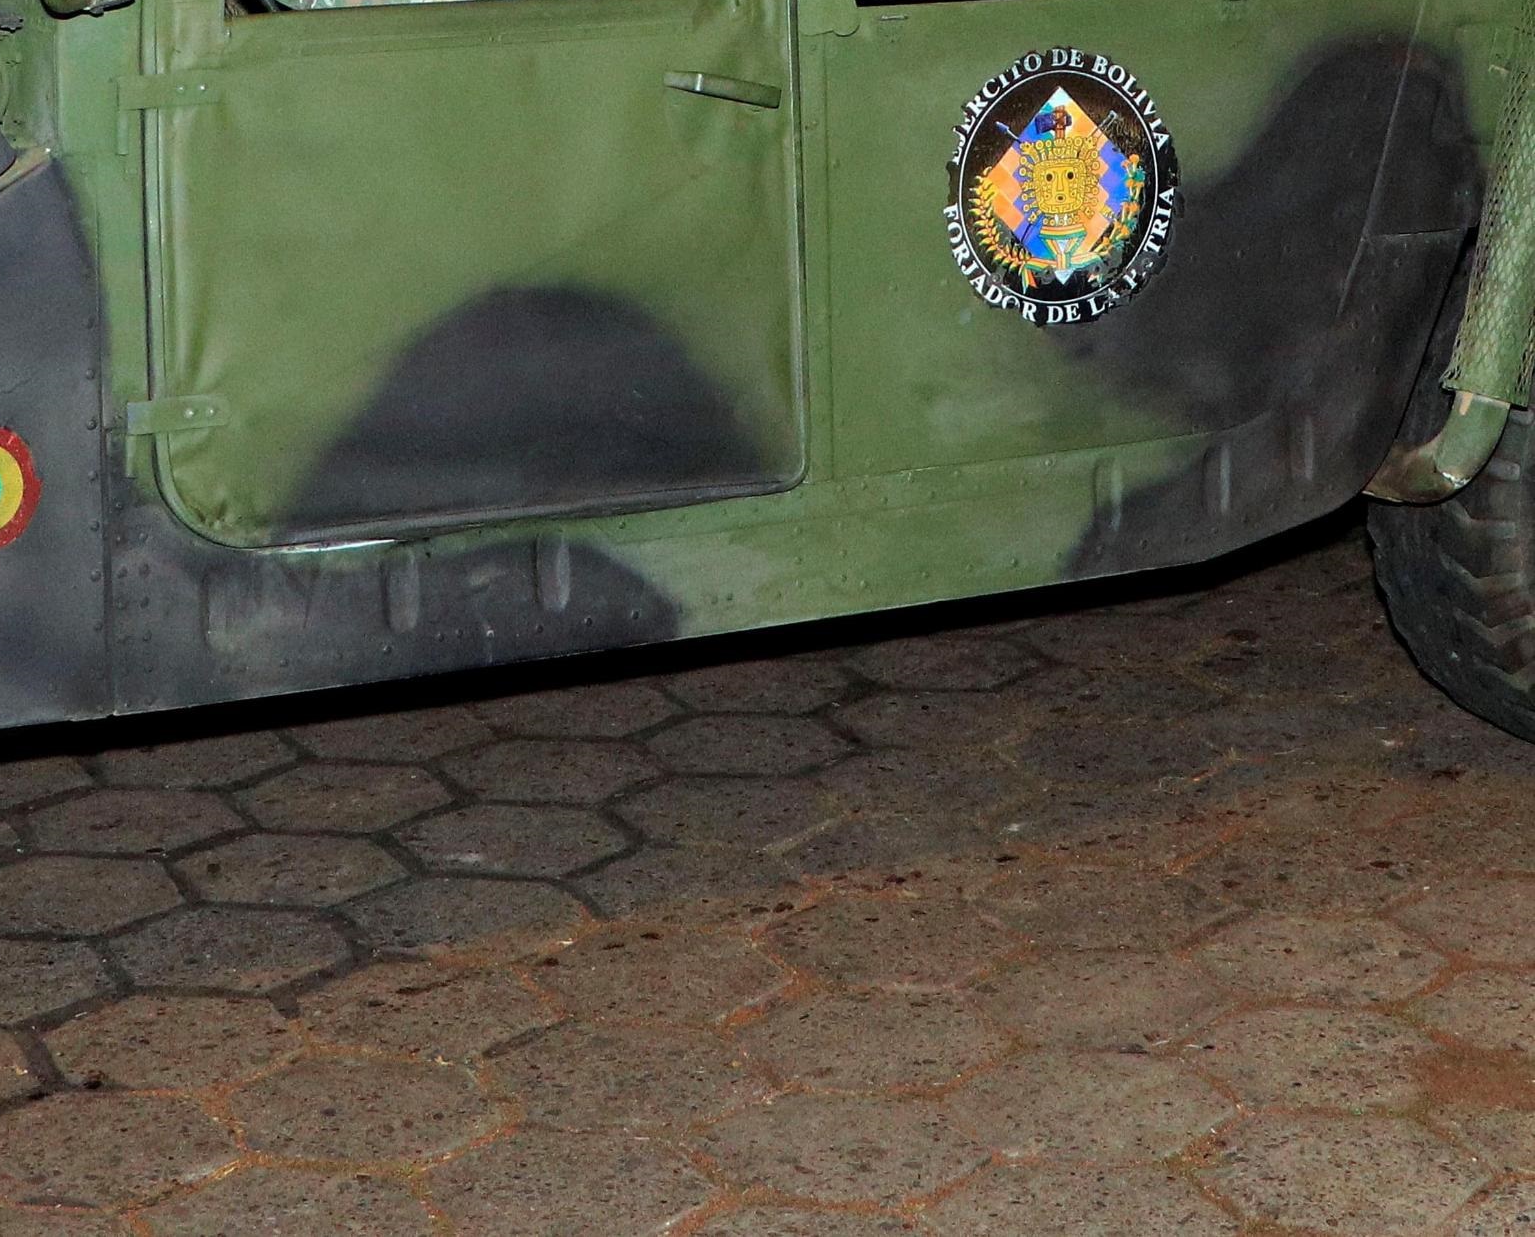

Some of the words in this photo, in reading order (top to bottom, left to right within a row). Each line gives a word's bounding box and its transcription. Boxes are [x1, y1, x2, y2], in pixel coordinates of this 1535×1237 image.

[1051, 48, 1085, 67] DE
[1091, 54, 1169, 150] BOLIVIA
[943, 203, 1037, 322] FORJADOR
[1046, 305, 1081, 323] DE
[1123, 187, 1174, 289] PTRIA
